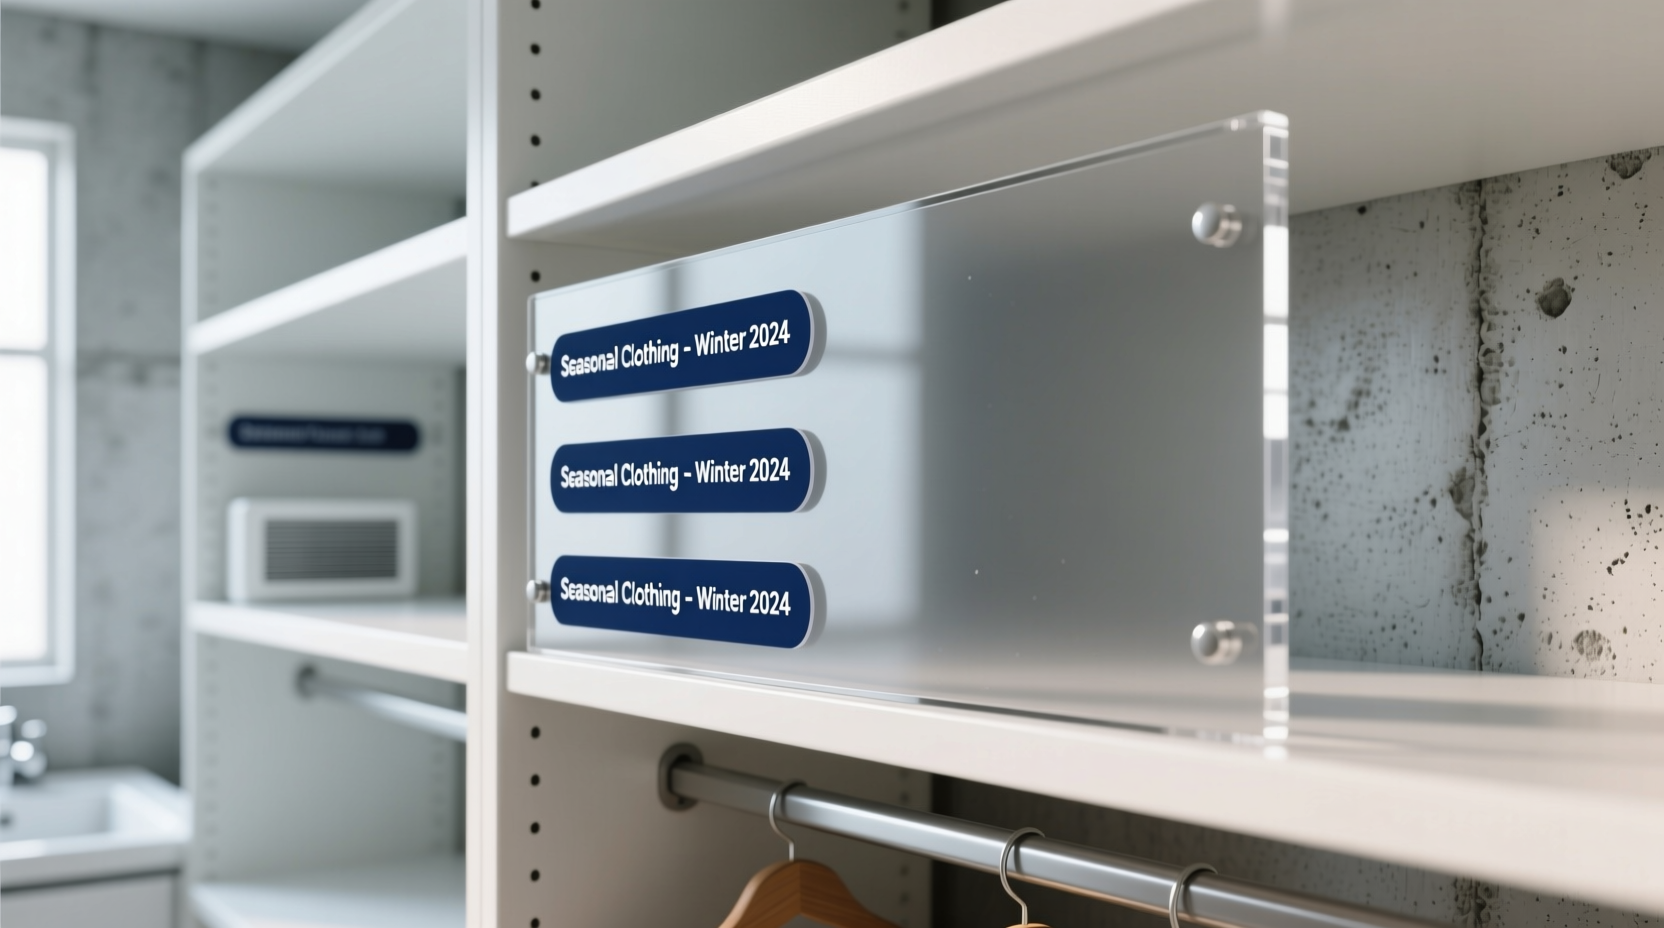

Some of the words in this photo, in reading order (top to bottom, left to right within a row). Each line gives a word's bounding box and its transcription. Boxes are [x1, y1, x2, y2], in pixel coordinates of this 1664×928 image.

[560, 345, 619, 378] Seasonal
[621, 338, 679, 368] Clothing
[694, 329, 747, 357] Winter
[748, 319, 791, 349] 2024
[560, 463, 619, 489] Seasonal
[620, 460, 679, 492] Clothing
[694, 459, 747, 484] Winter
[749, 456, 791, 482] 2024
[560, 576, 619, 604] Seasonal
[621, 580, 681, 616] Clothing
[696, 585, 747, 613] Winter
[749, 589, 792, 616] 2024
